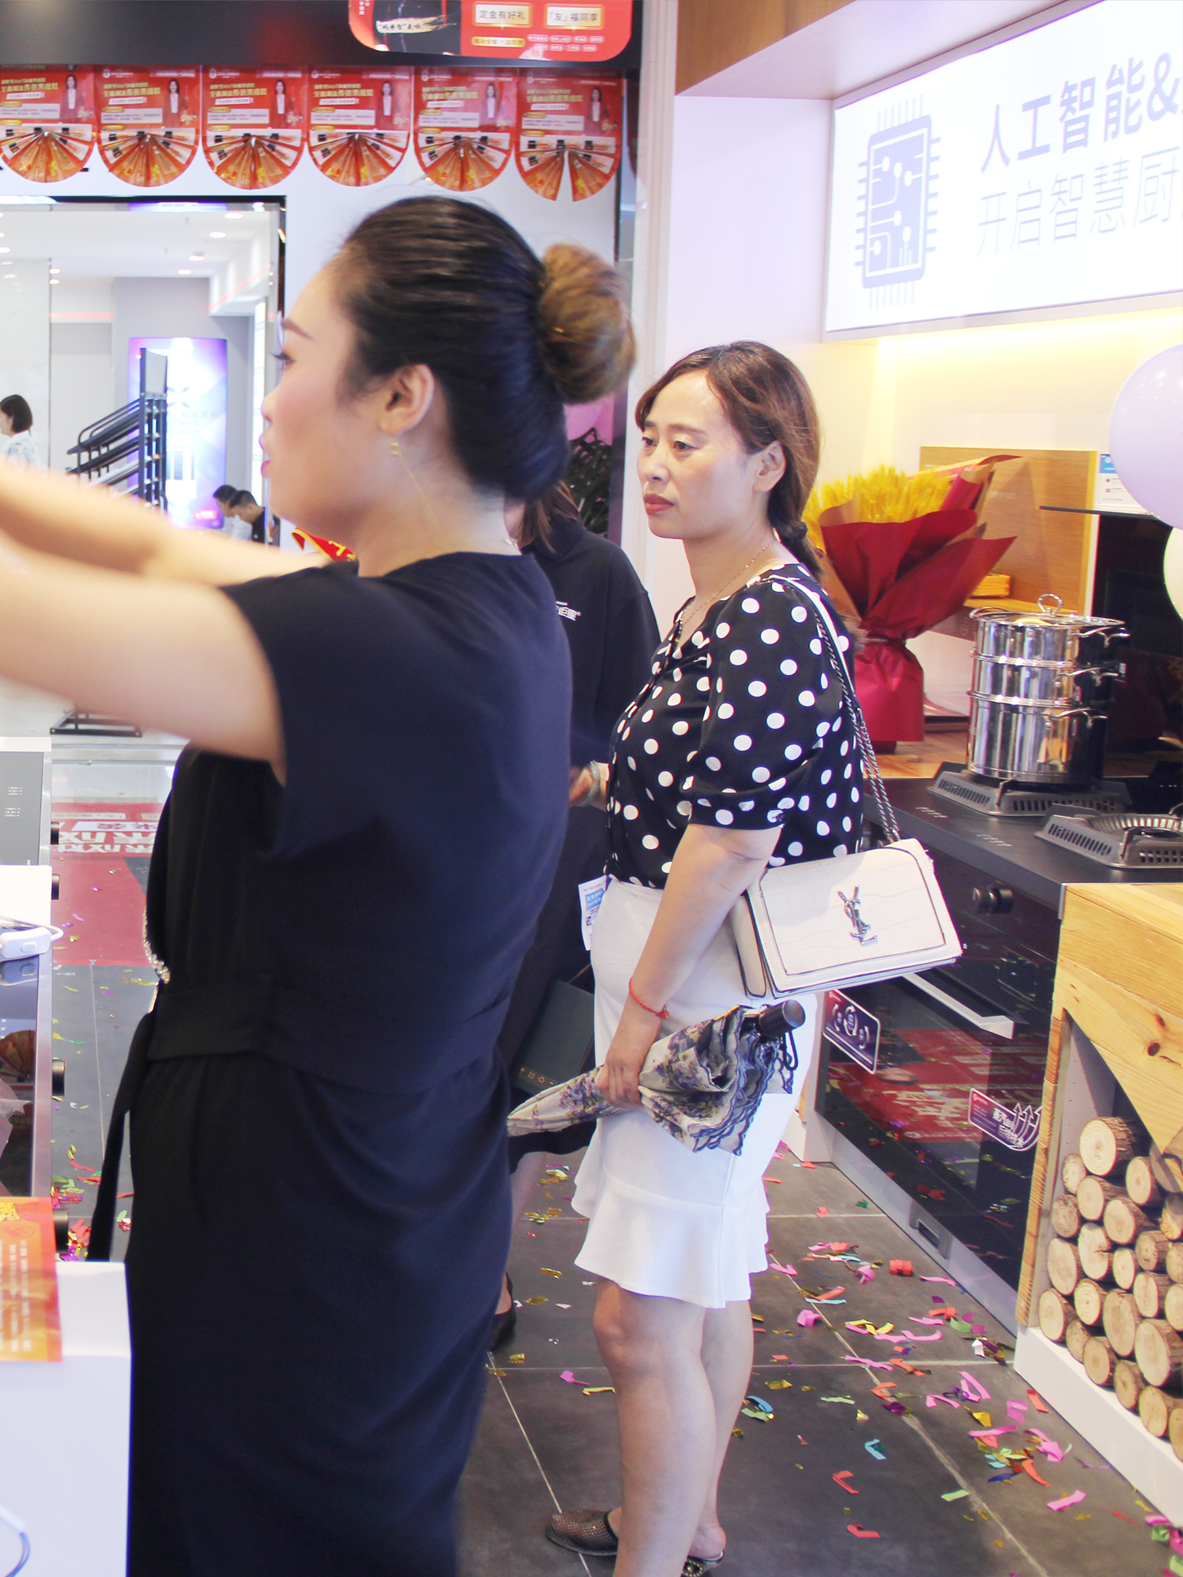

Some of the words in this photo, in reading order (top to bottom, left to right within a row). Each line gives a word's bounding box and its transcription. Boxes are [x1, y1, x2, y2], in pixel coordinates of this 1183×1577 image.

[479, 9, 527, 20] 定金有好礼
[979, 52, 1180, 174] 人工智能&
[977, 146, 1181, 256] 开启智慧厨
